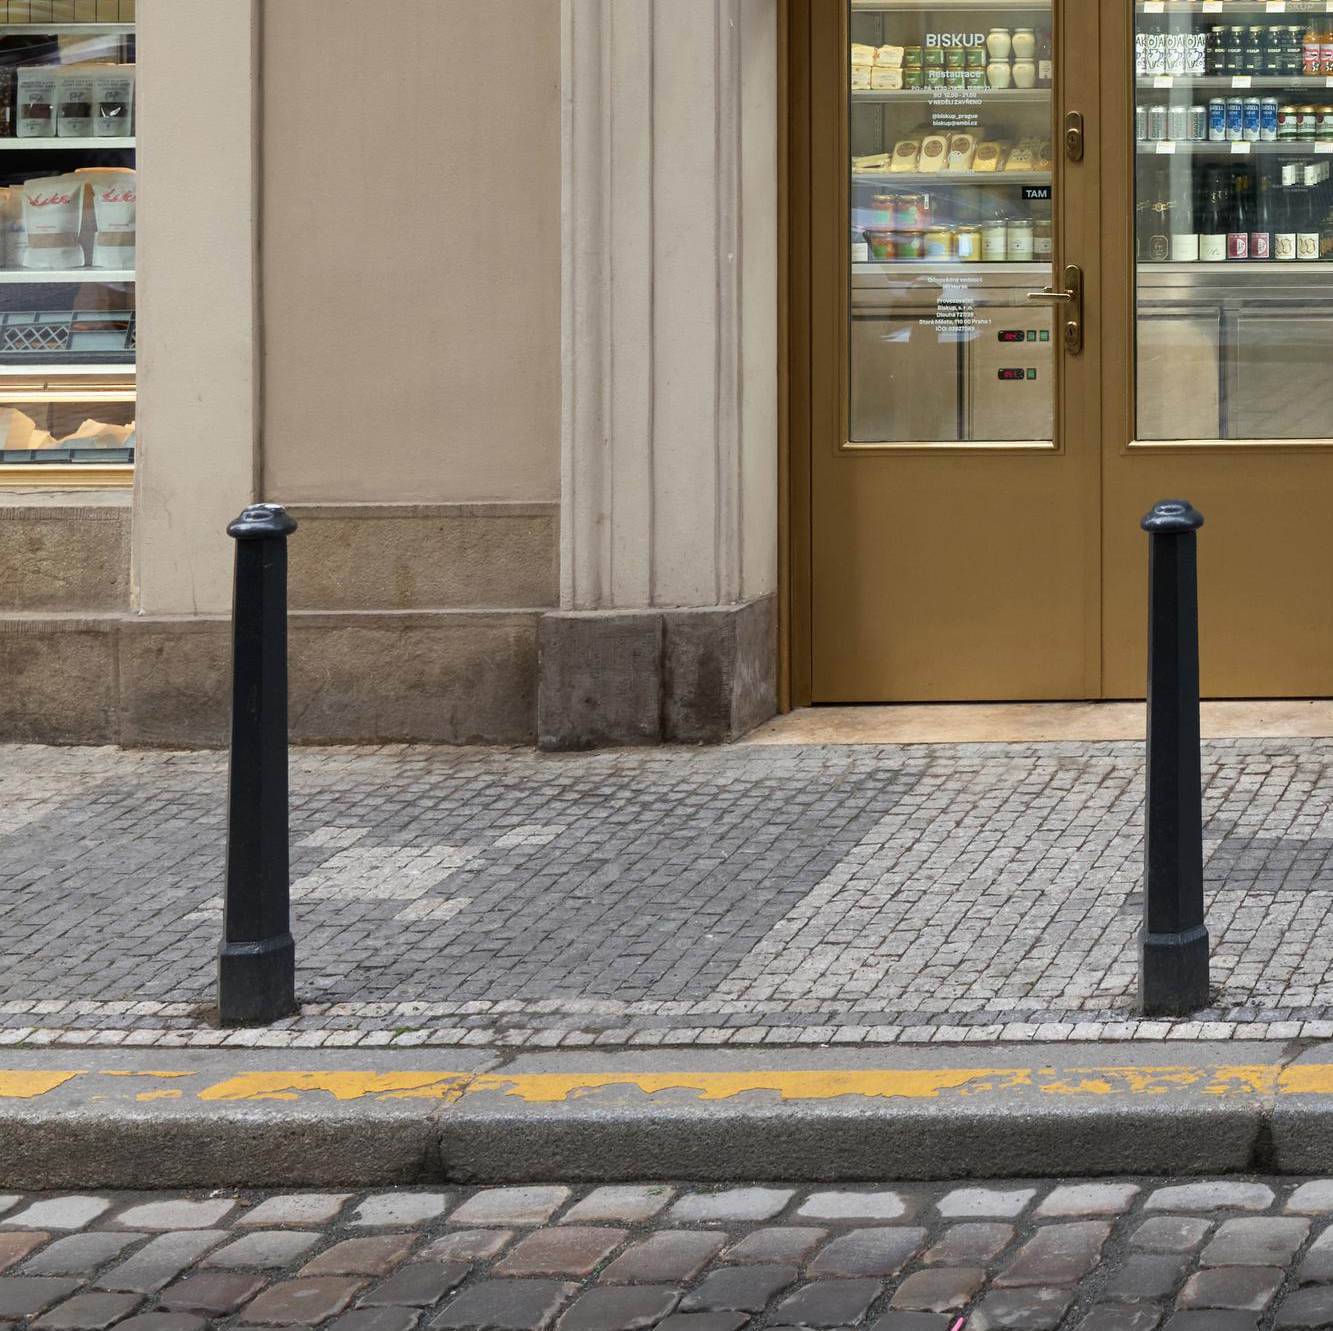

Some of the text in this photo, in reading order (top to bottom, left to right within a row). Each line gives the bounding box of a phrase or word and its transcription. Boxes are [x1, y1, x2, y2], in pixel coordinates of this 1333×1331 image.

[926, 33, 985, 47] BISKUP
[929, 70, 981, 78] Restaurace
[1026, 189, 1047, 198] TAM
